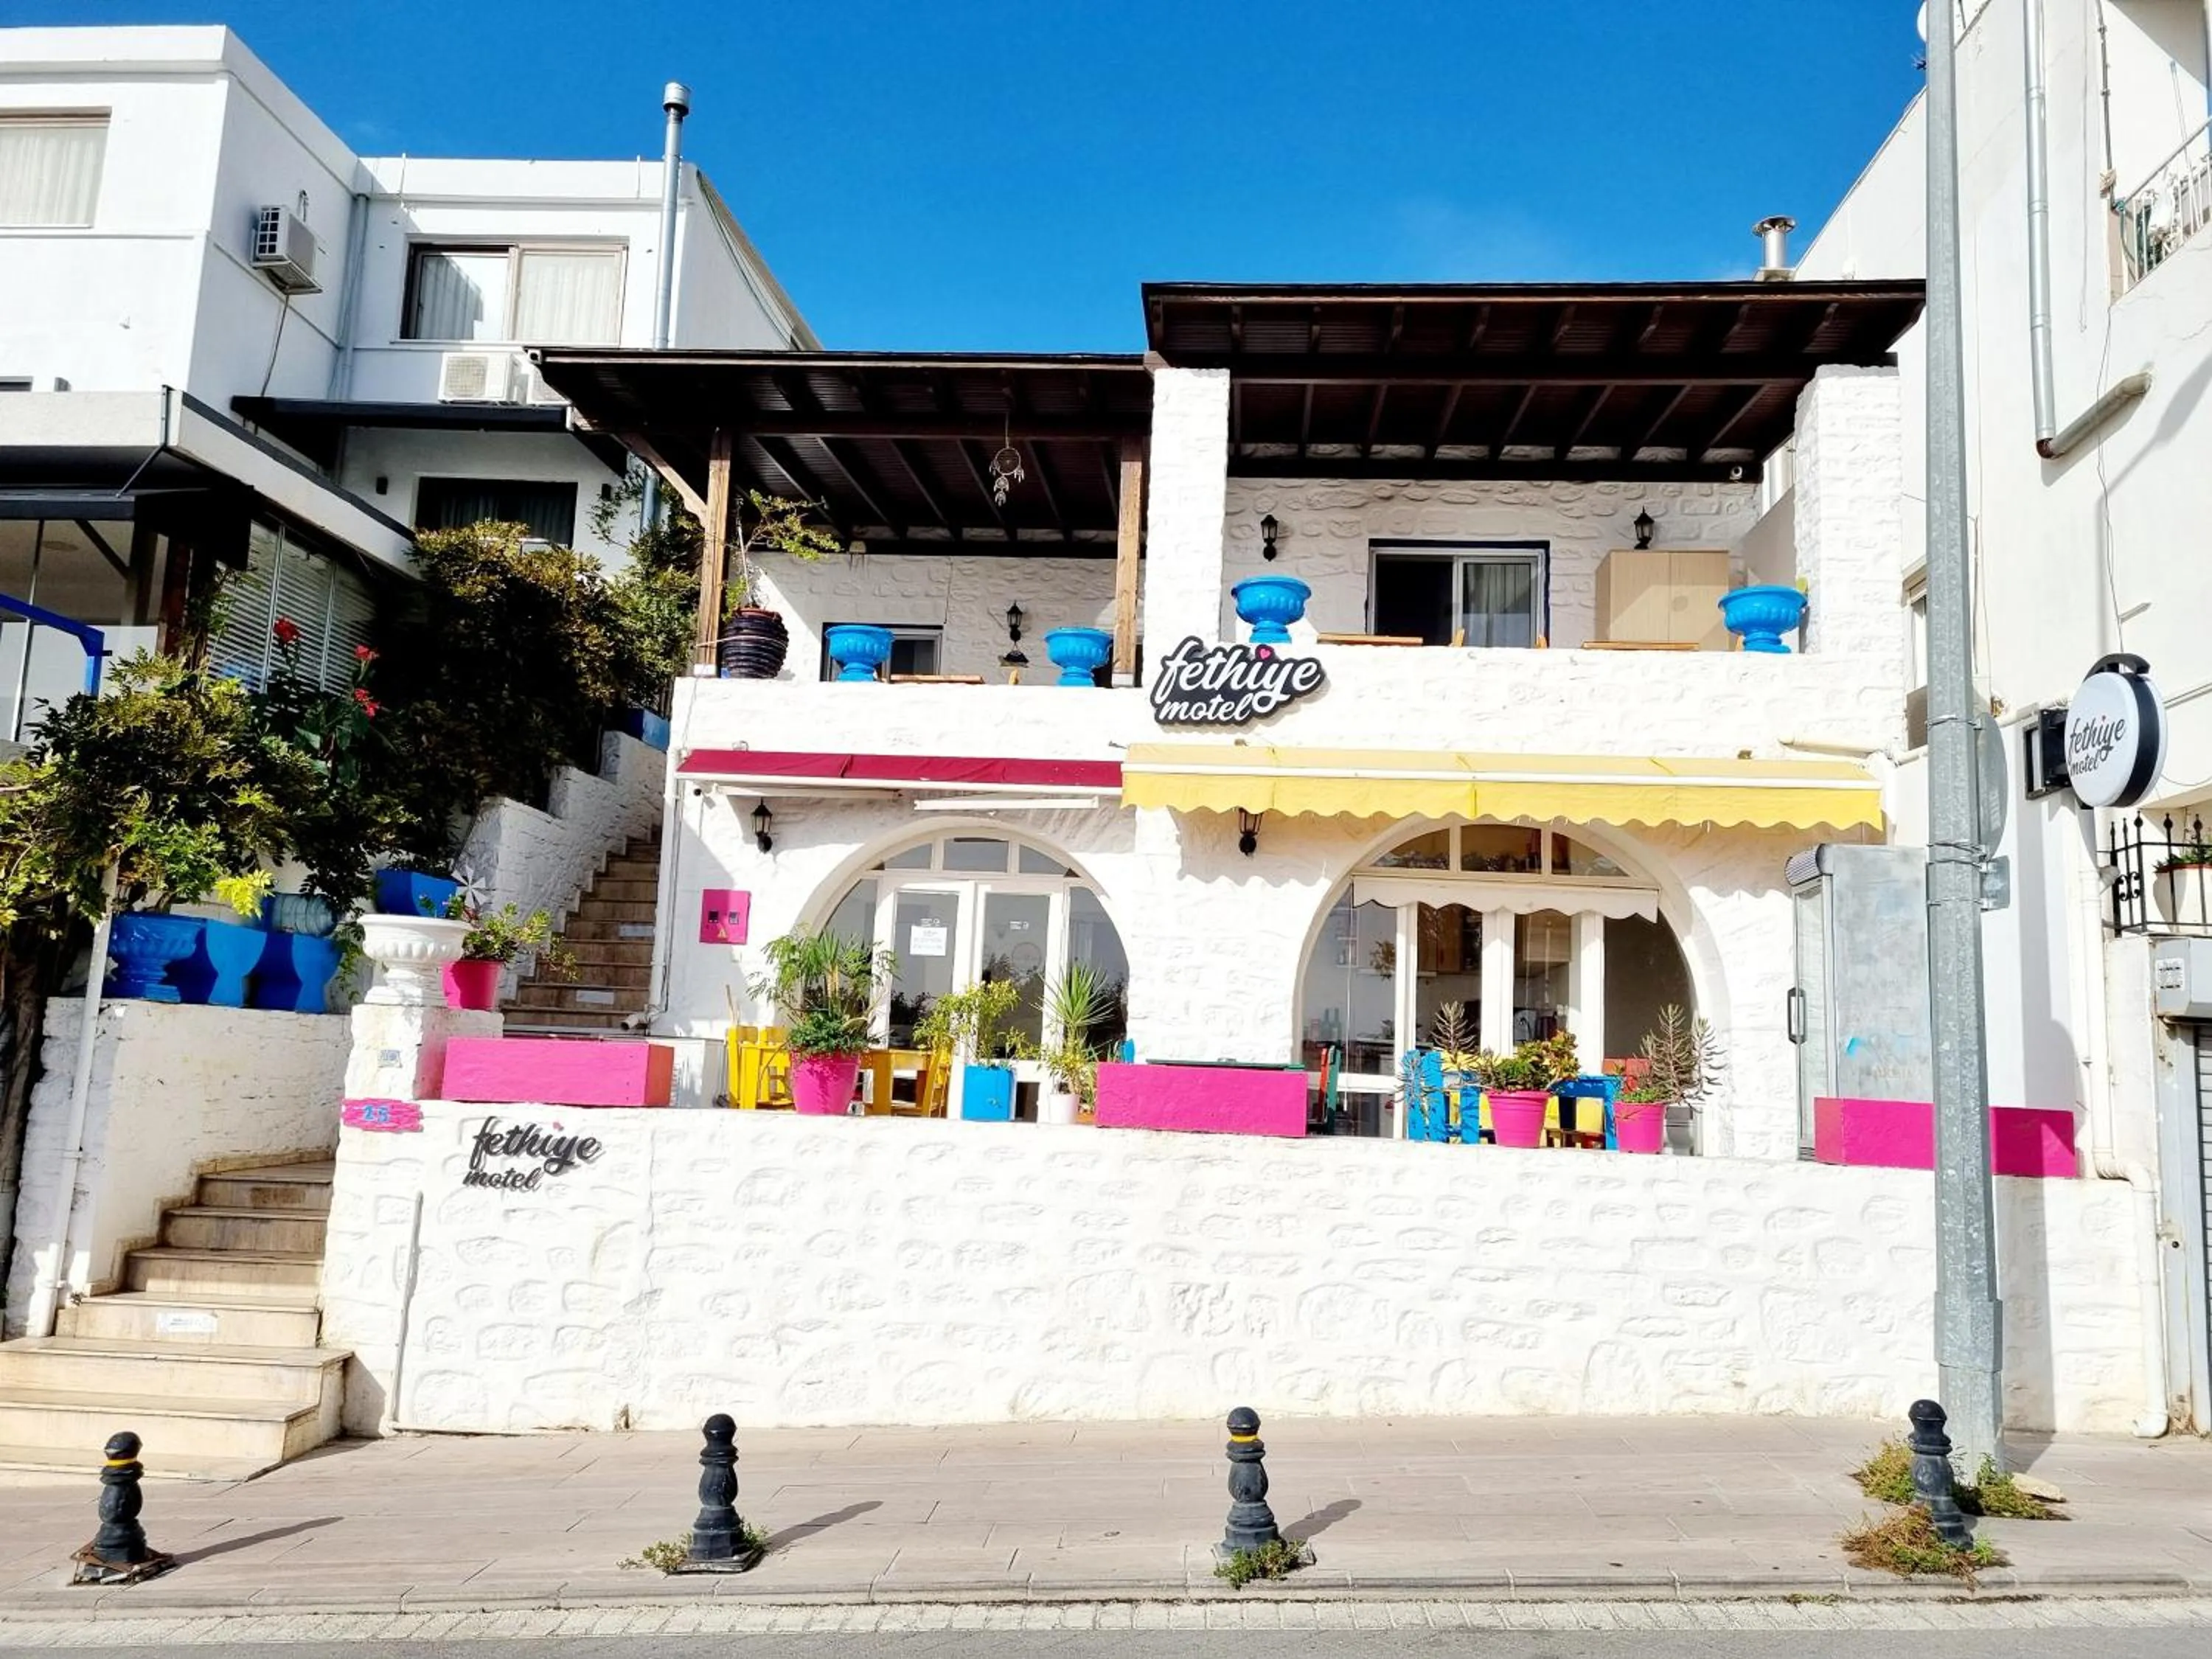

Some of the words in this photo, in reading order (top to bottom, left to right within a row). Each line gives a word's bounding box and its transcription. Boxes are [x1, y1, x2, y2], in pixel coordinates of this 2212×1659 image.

[1154, 639, 1321, 714] fethiye
[1158, 694, 1253, 720] motel
[2068, 715, 2126, 766] fethiye
[2070, 751, 2101, 776] motel
[469, 1116, 601, 1175] fethiye
[462, 1166, 542, 1189] motel
